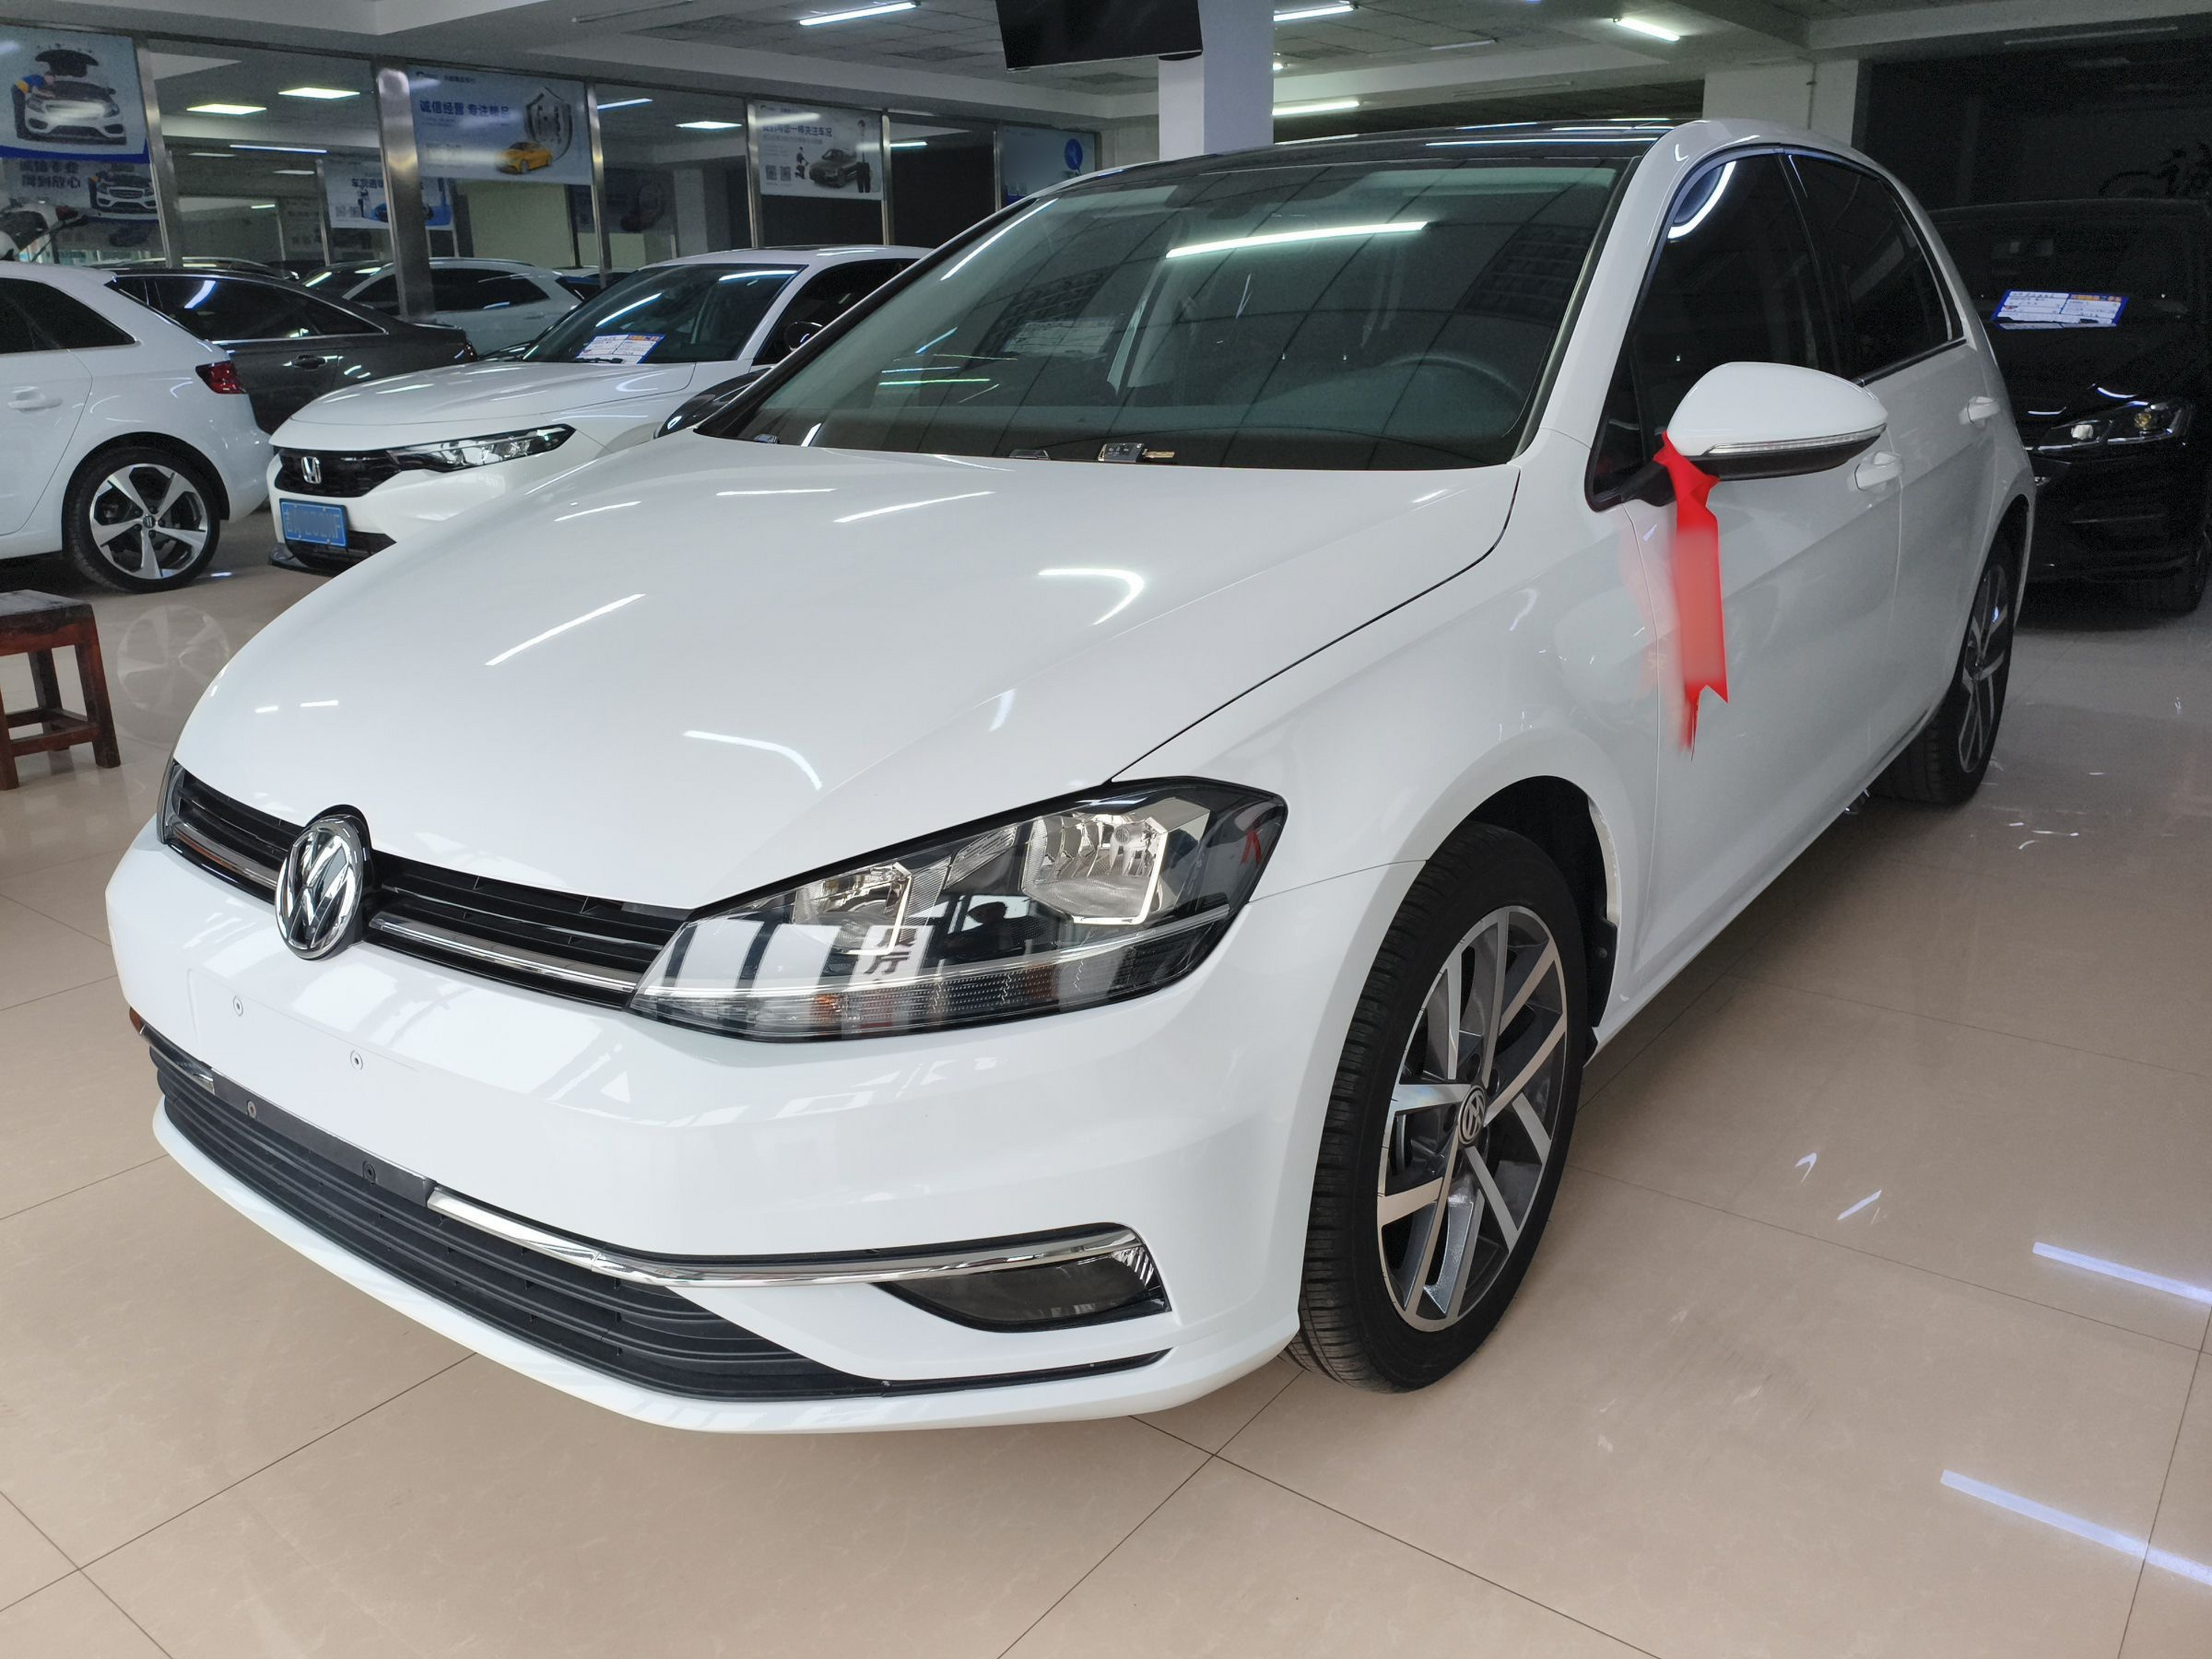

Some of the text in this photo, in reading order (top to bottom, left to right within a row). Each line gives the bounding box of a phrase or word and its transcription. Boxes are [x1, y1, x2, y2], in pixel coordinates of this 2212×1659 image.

[419, 100, 464, 115] 诚信经营
[863, 927, 918, 980] 展厅
